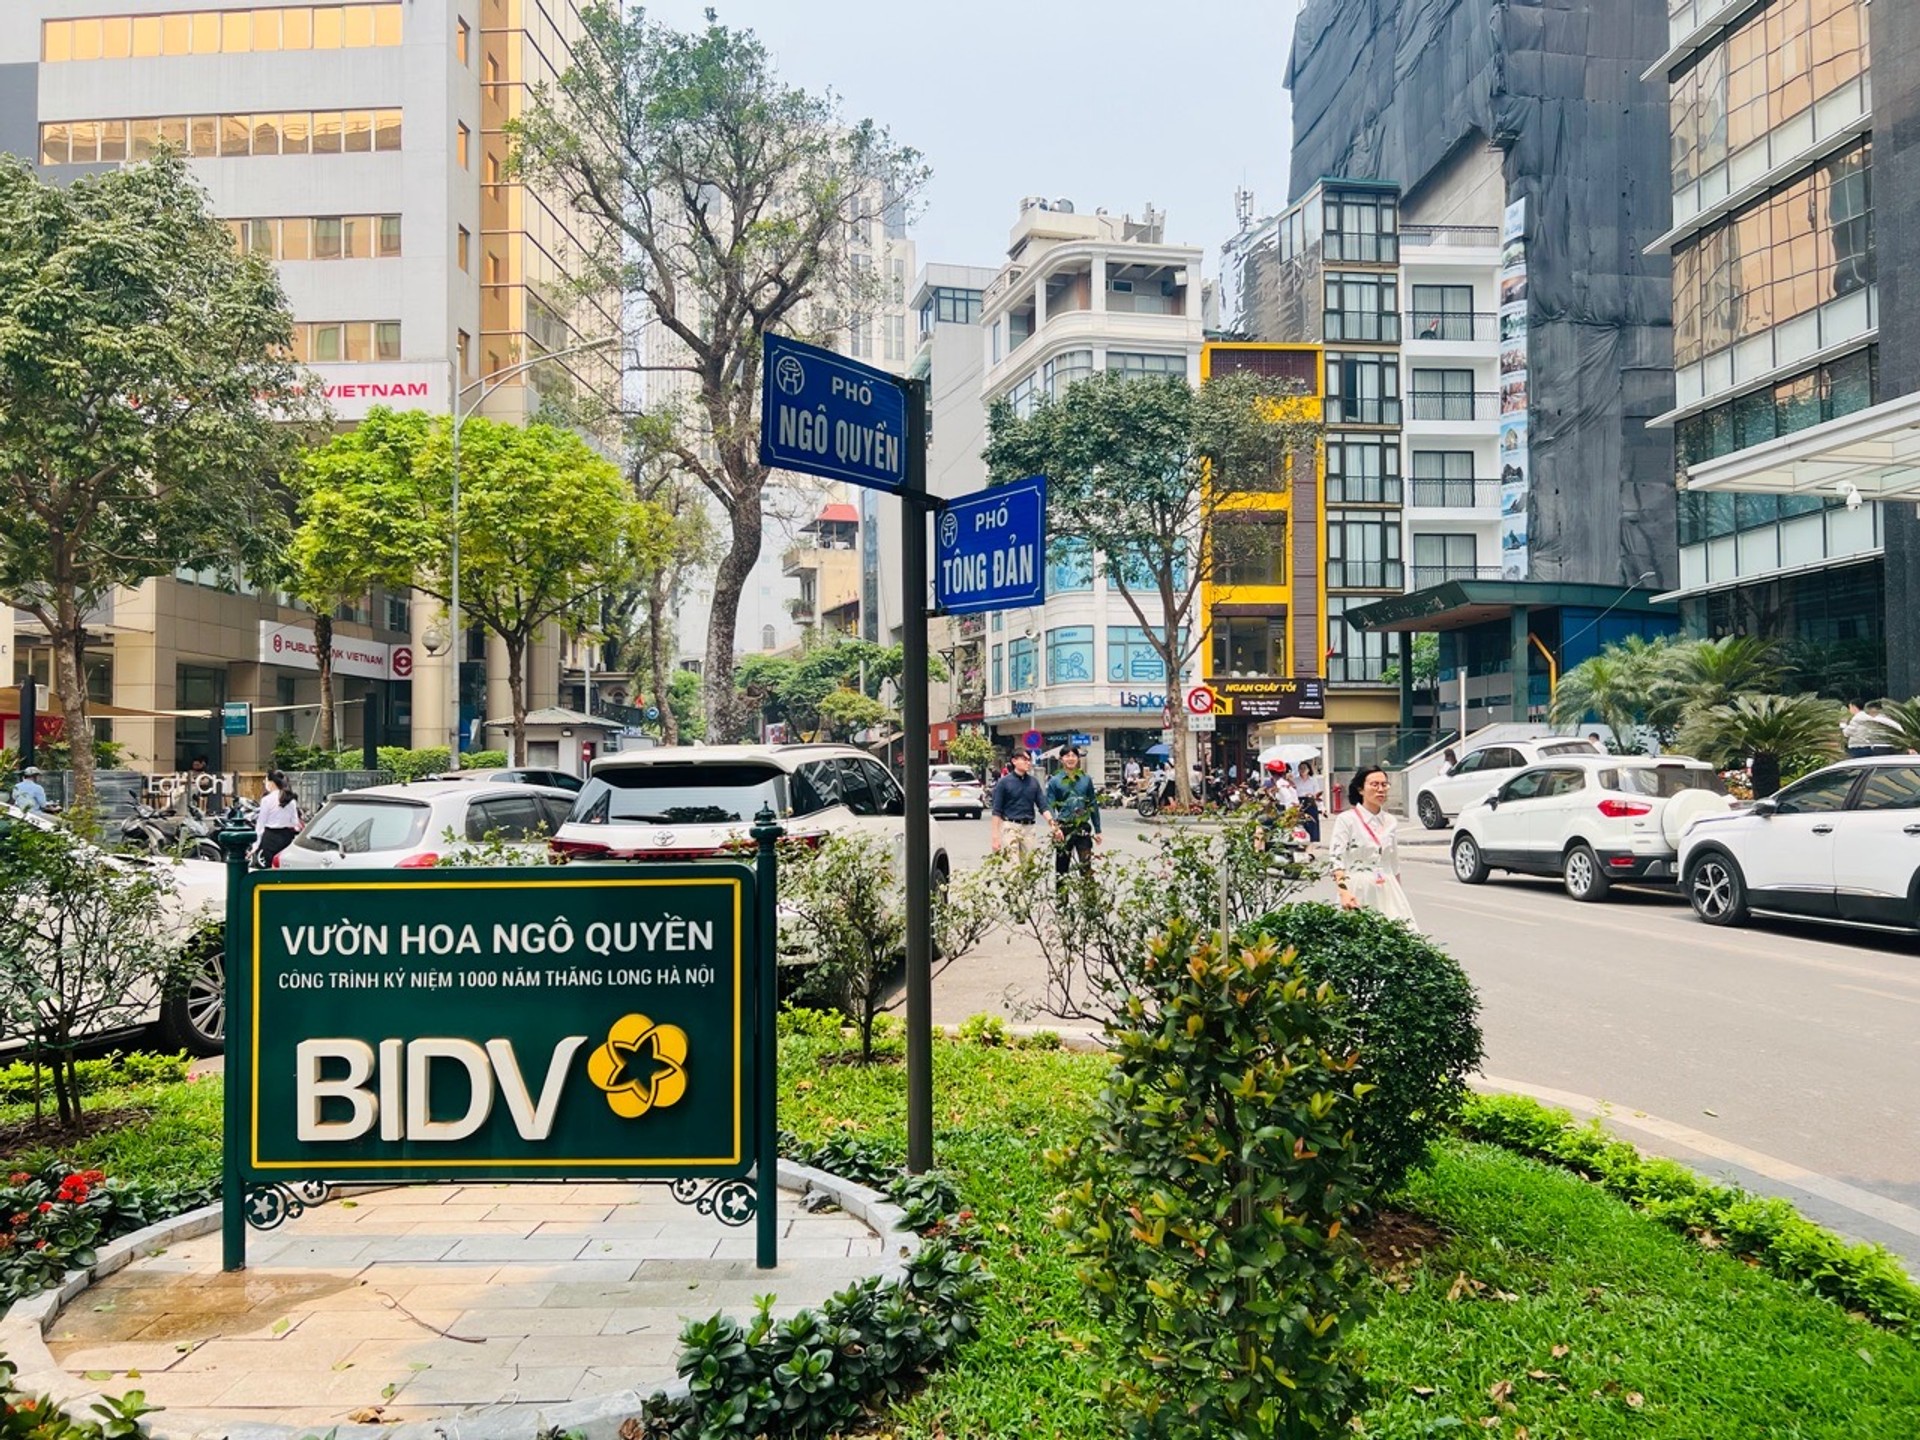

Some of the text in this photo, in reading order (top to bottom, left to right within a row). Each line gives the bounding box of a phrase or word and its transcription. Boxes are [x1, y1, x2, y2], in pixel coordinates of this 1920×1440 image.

[322, 383, 428, 398] VIETNAM
[831, 376, 875, 406] PHỐ
[779, 403, 899, 474] NGÔ QUYỀN
[975, 498, 1010, 532] PHỐ
[943, 533, 1034, 595] TÔNG ĐẢN
[285, 640, 317, 655] PUBLIC
[346, 649, 384, 665] VIETNAM
[282, 912, 713, 956] VƯỜN HOA NGÔ QUYỀN
[278, 969, 324, 989] CÔNG
[328, 969, 379, 989] TRÌNH
[410, 967, 453, 991] NIỆM
[458, 971, 498, 987] 1000
[502, 967, 540, 987] NĂM
[545, 966, 603, 987] THĂNG
[607, 969, 652, 985] LONG
[657, 965, 681, 985] HÀ
[685, 964, 714, 987] NỘI
[296, 1036, 588, 1142] BIDV
